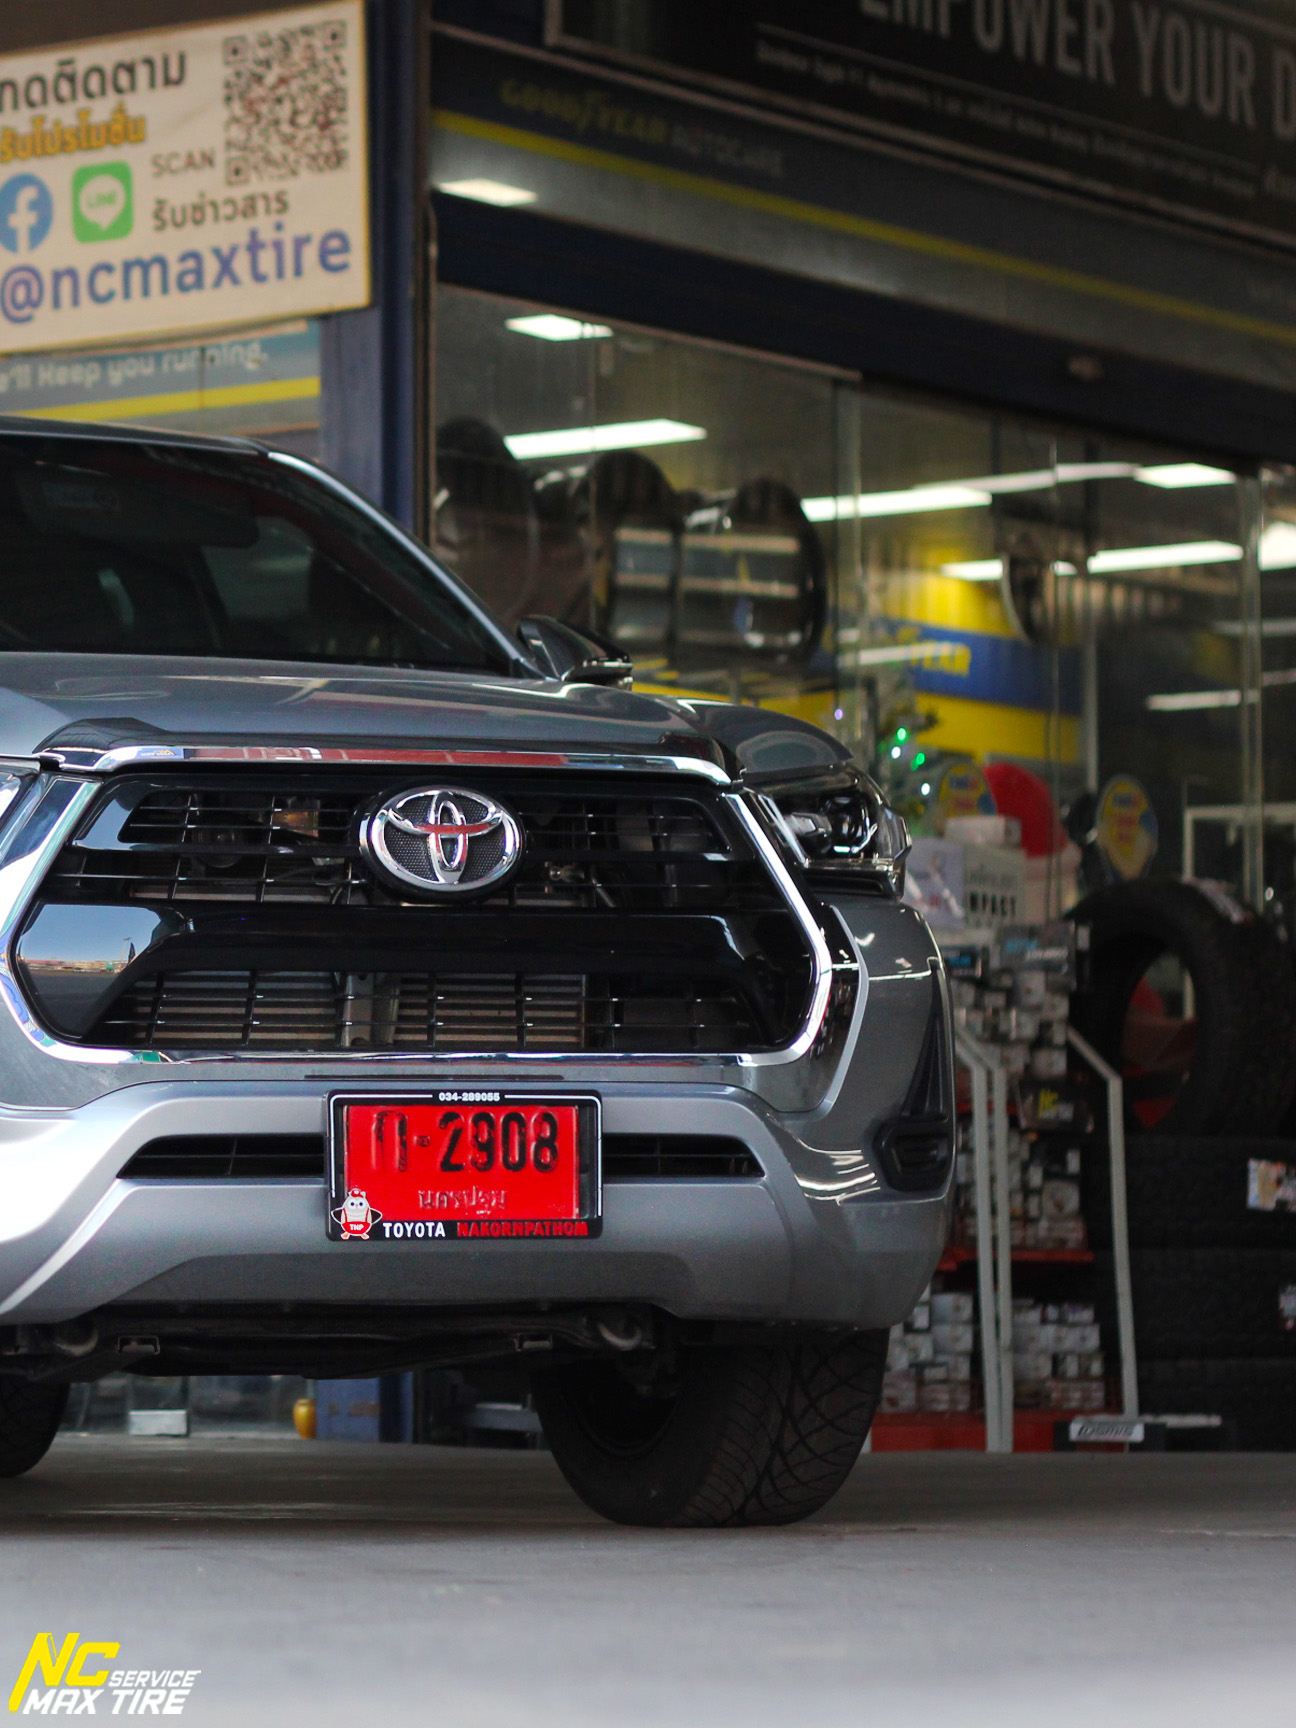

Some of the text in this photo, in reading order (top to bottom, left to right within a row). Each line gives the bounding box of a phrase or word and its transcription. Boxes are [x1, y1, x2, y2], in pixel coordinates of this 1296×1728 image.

[861, 0, 1116, 84] OWER
[1132, 2, 1256, 129] YOUR
[152, 149, 218, 178] SCAN
[152, 190, 290, 232] รับข่าวสาร
[0, 222, 352, 324] @ncmaxtire
[107, 355, 154, 386] you
[438, 1092, 501, 1102] 034-289055
[382, 1221, 589, 1238] TOYOTA NAKORNPATHOM
